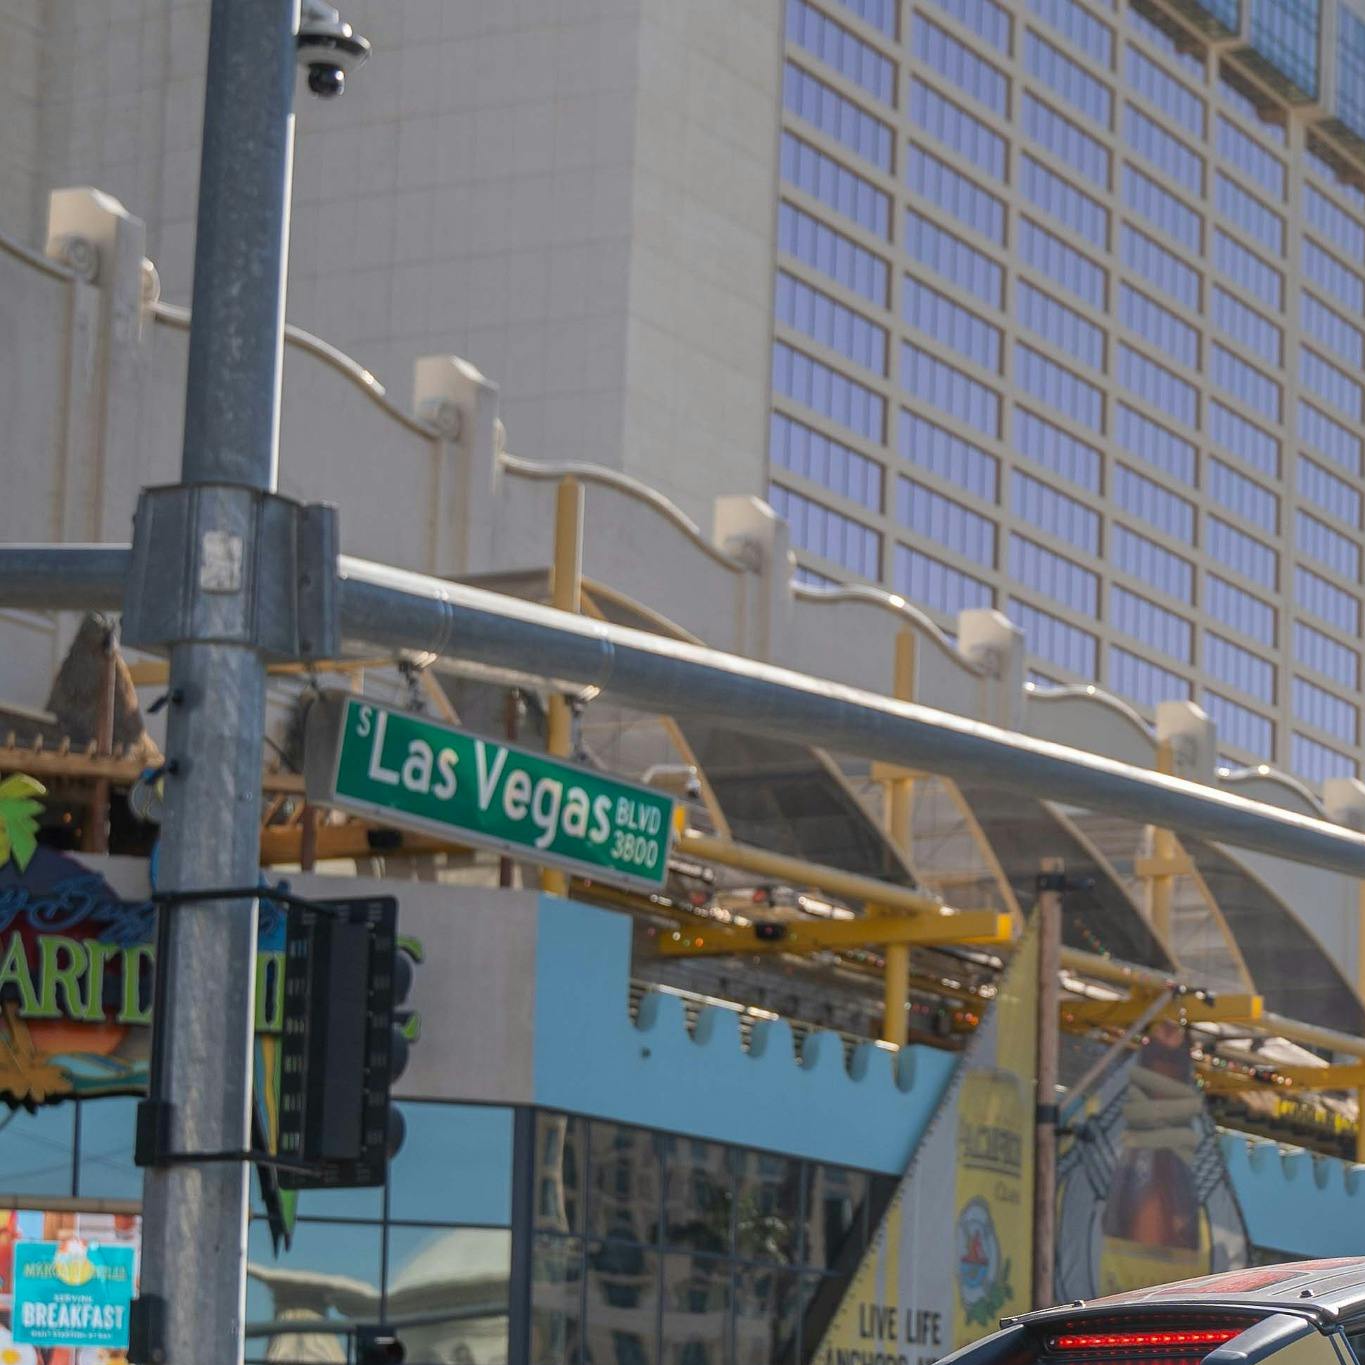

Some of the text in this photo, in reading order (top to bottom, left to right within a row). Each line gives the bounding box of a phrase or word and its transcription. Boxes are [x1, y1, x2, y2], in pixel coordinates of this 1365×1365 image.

[356, 705, 662, 848] S Las Vegas BLVD
[610, 833, 659, 869] 3800
[22, 1301, 126, 1330] BREAKFAST
[859, 1302, 942, 1345] LIVE LIFE
